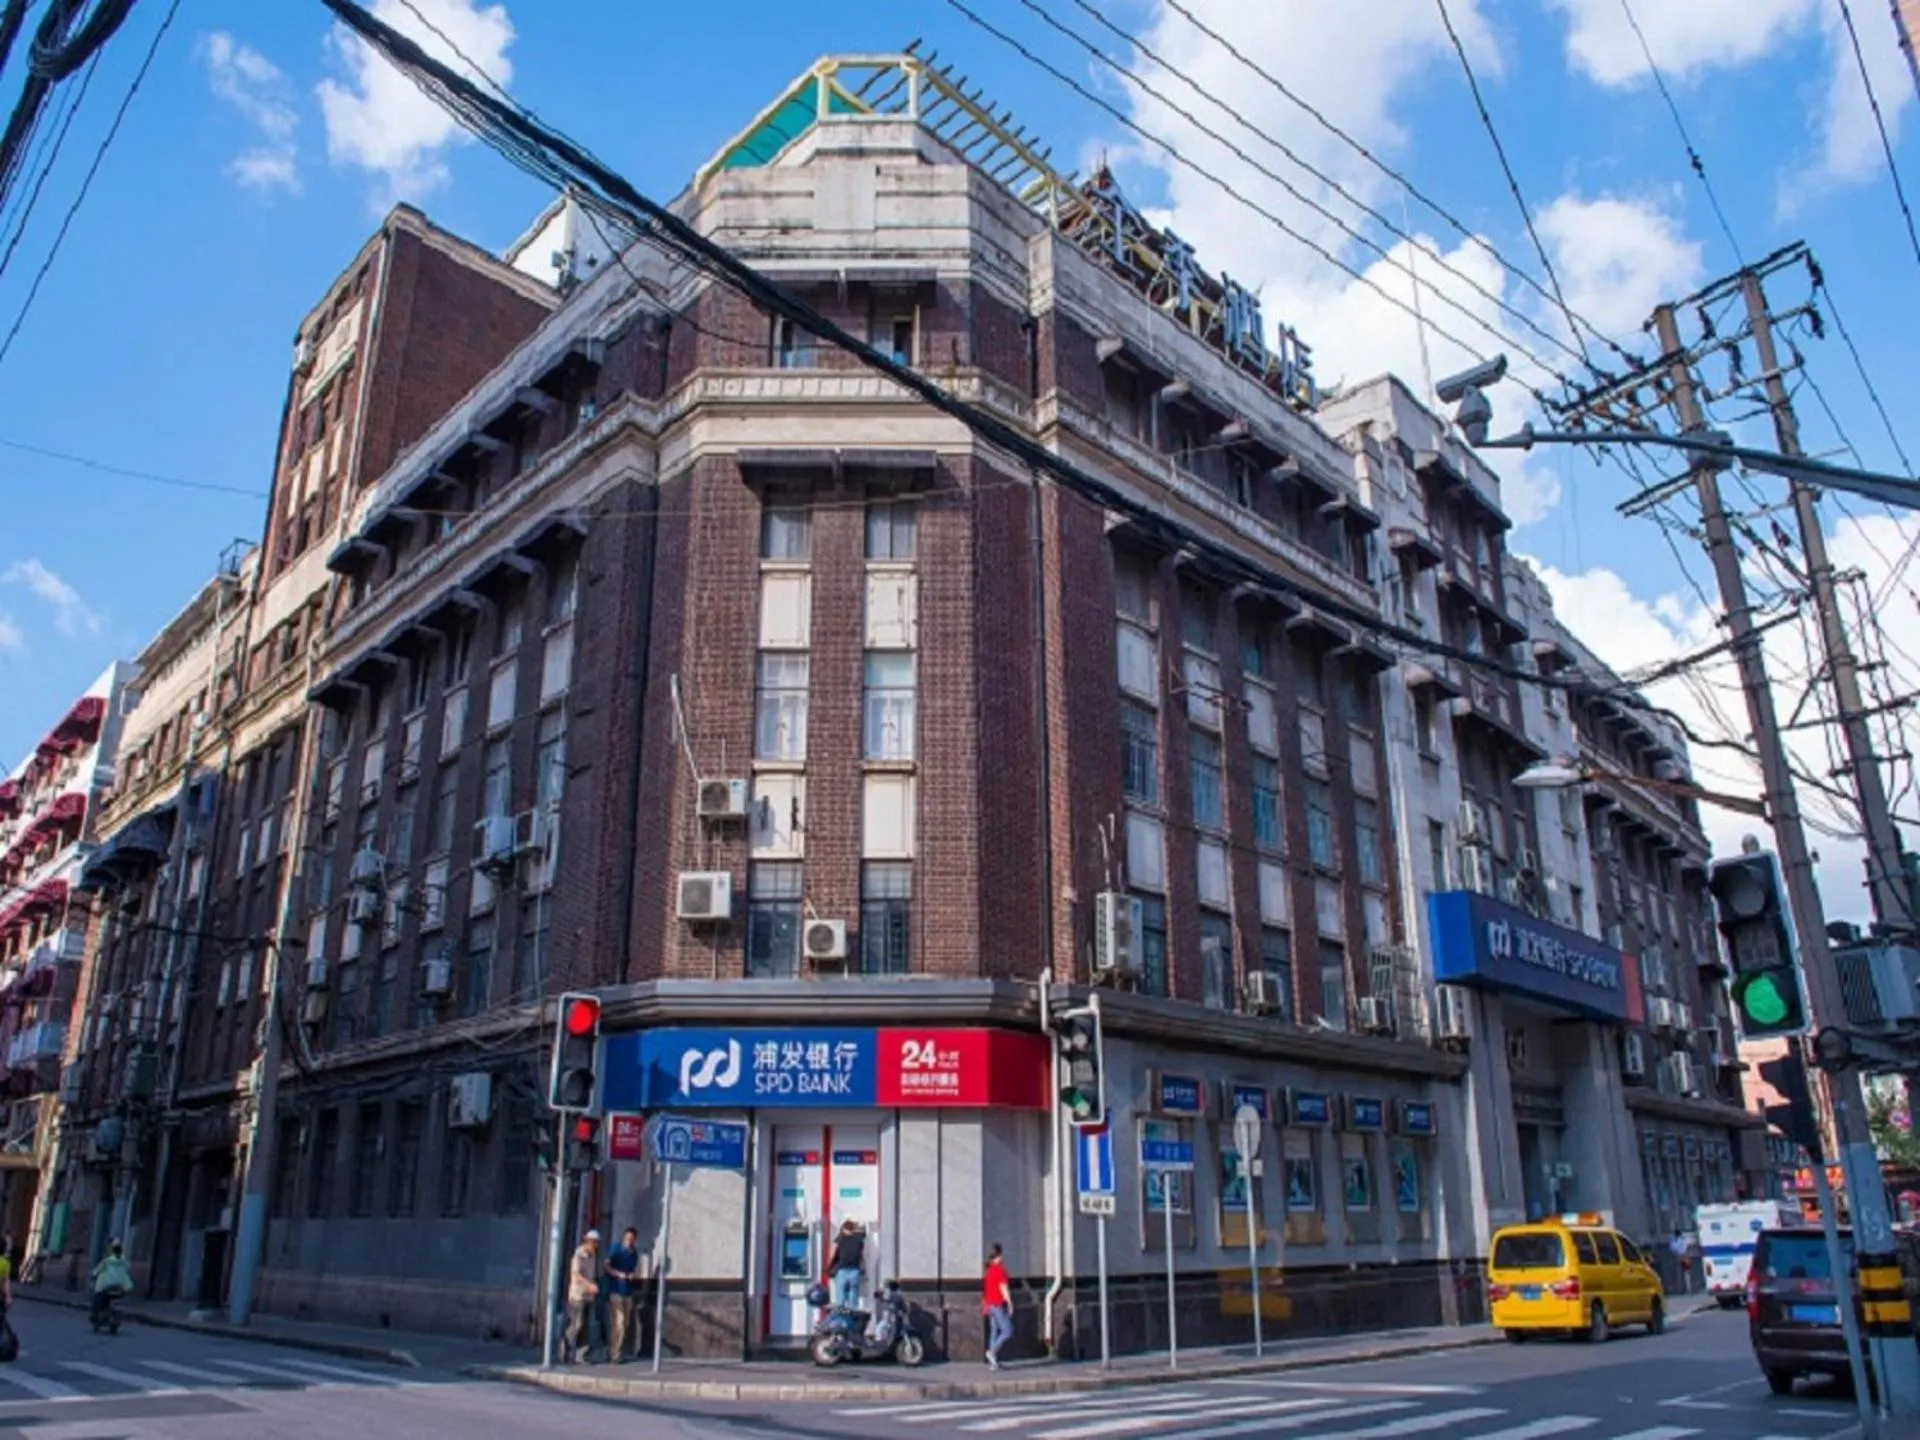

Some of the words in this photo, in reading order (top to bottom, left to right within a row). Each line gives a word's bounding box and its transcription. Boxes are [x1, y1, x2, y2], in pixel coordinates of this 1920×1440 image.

[753, 1040, 859, 1071] 浦发银行
[901, 1040, 936, 1069] 24
[754, 1073, 793, 1093] SPD
[798, 1073, 851, 1093] BANK
